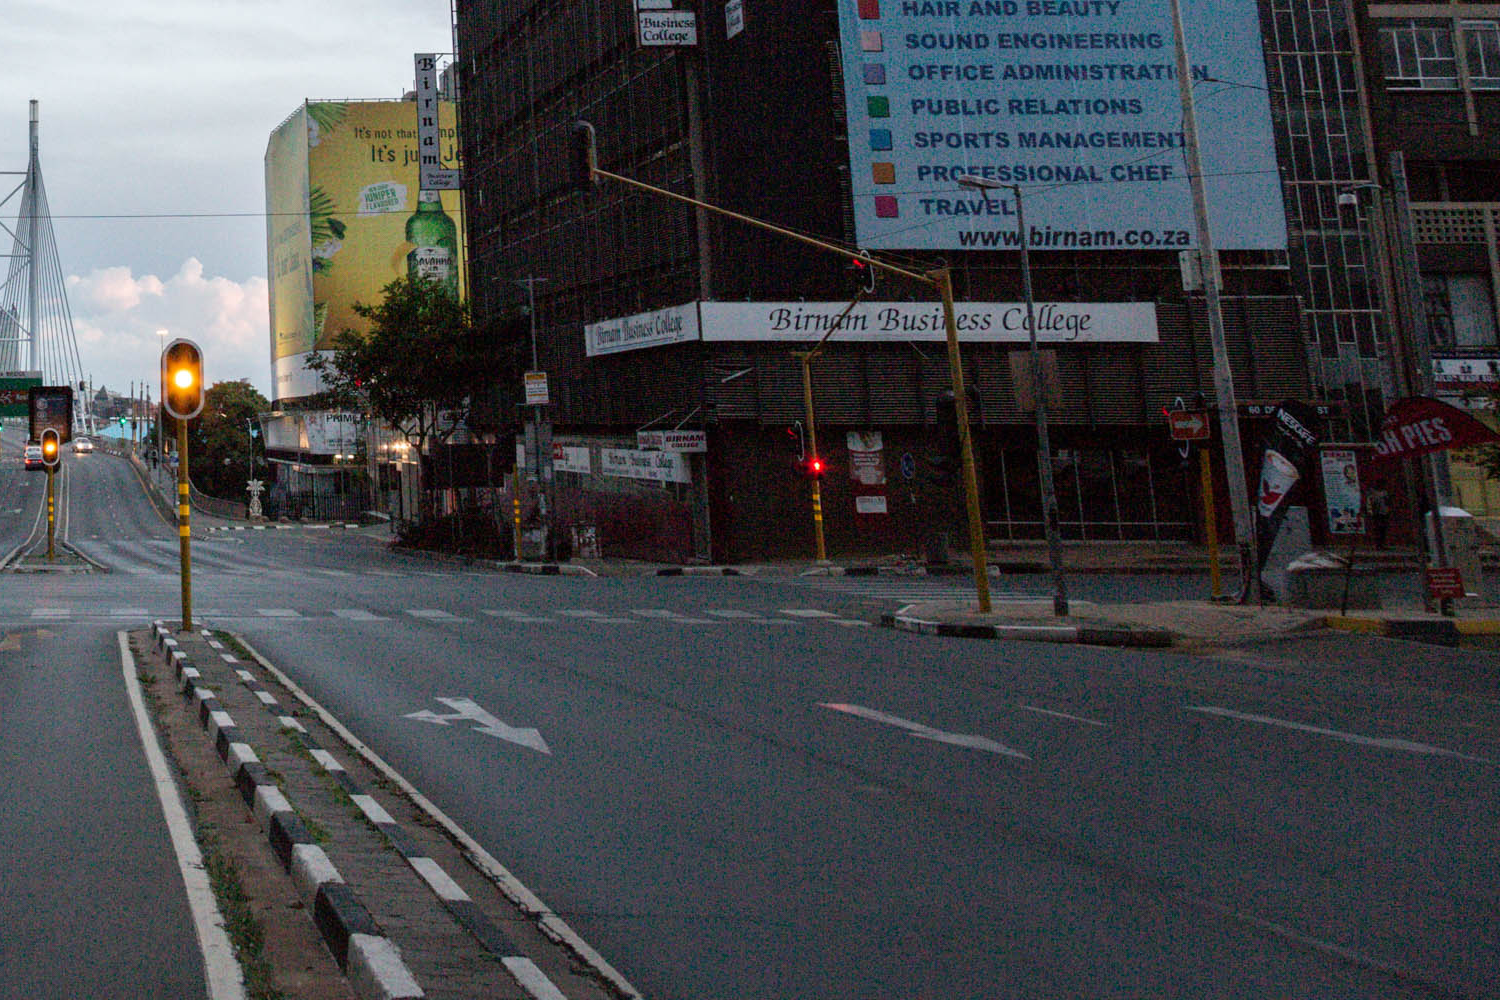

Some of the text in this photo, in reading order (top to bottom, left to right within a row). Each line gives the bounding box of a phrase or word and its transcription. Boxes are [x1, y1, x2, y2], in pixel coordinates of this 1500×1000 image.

[902, 0, 1121, 18] HAIR AND BEAUTY
[640, 17, 695, 29] Business
[643, 29, 689, 43] College
[905, 33, 1164, 50] SOUND ENGINEERING
[908, 64, 1209, 82] OFFICE ADMINISTRATIN
[417, 56, 439, 165] Birnam
[911, 98, 1143, 116] PUBLIC RELATIONS
[354, 126, 417, 139] It's not that
[914, 131, 1186, 149] SPORTS MANAGEMENT
[371, 144, 396, 163] It's
[917, 165, 1174, 182] PROFESSIONAL CHEF
[364, 188, 397, 203] JUNIPER
[920, 199, 1016, 216] TRAVEL
[959, 226, 1190, 248] wwwbirnam.co.za
[768, 306, 869, 332] Birnam
[1002, 304, 1092, 341] College
[1316, 406, 1334, 415] ST
[665, 434, 705, 442] BIRNAM
[1399, 416, 1453, 449] PIES
